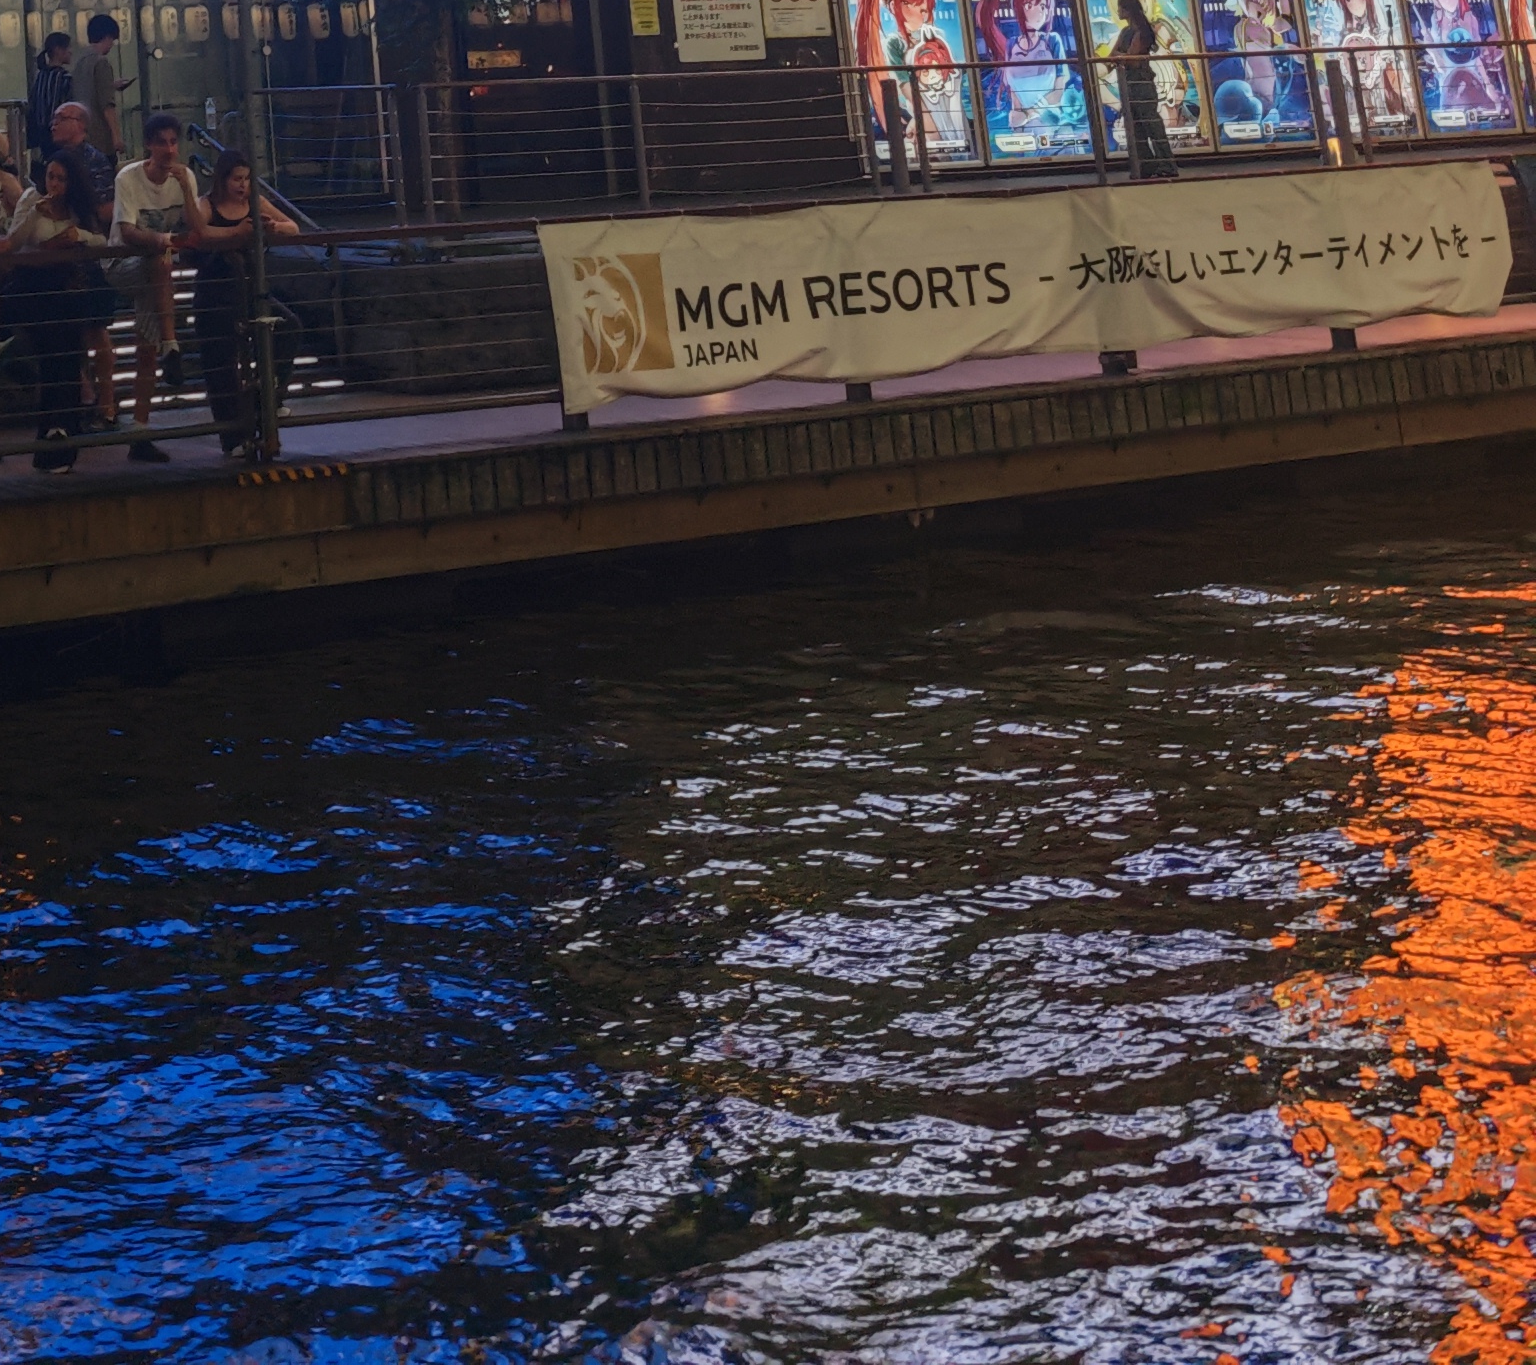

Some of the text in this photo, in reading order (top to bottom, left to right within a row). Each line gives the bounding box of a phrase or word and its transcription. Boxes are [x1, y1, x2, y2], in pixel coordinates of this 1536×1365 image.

[674, 262, 1012, 333] MGM RESORTS
[683, 338, 760, 368] JAPAN
